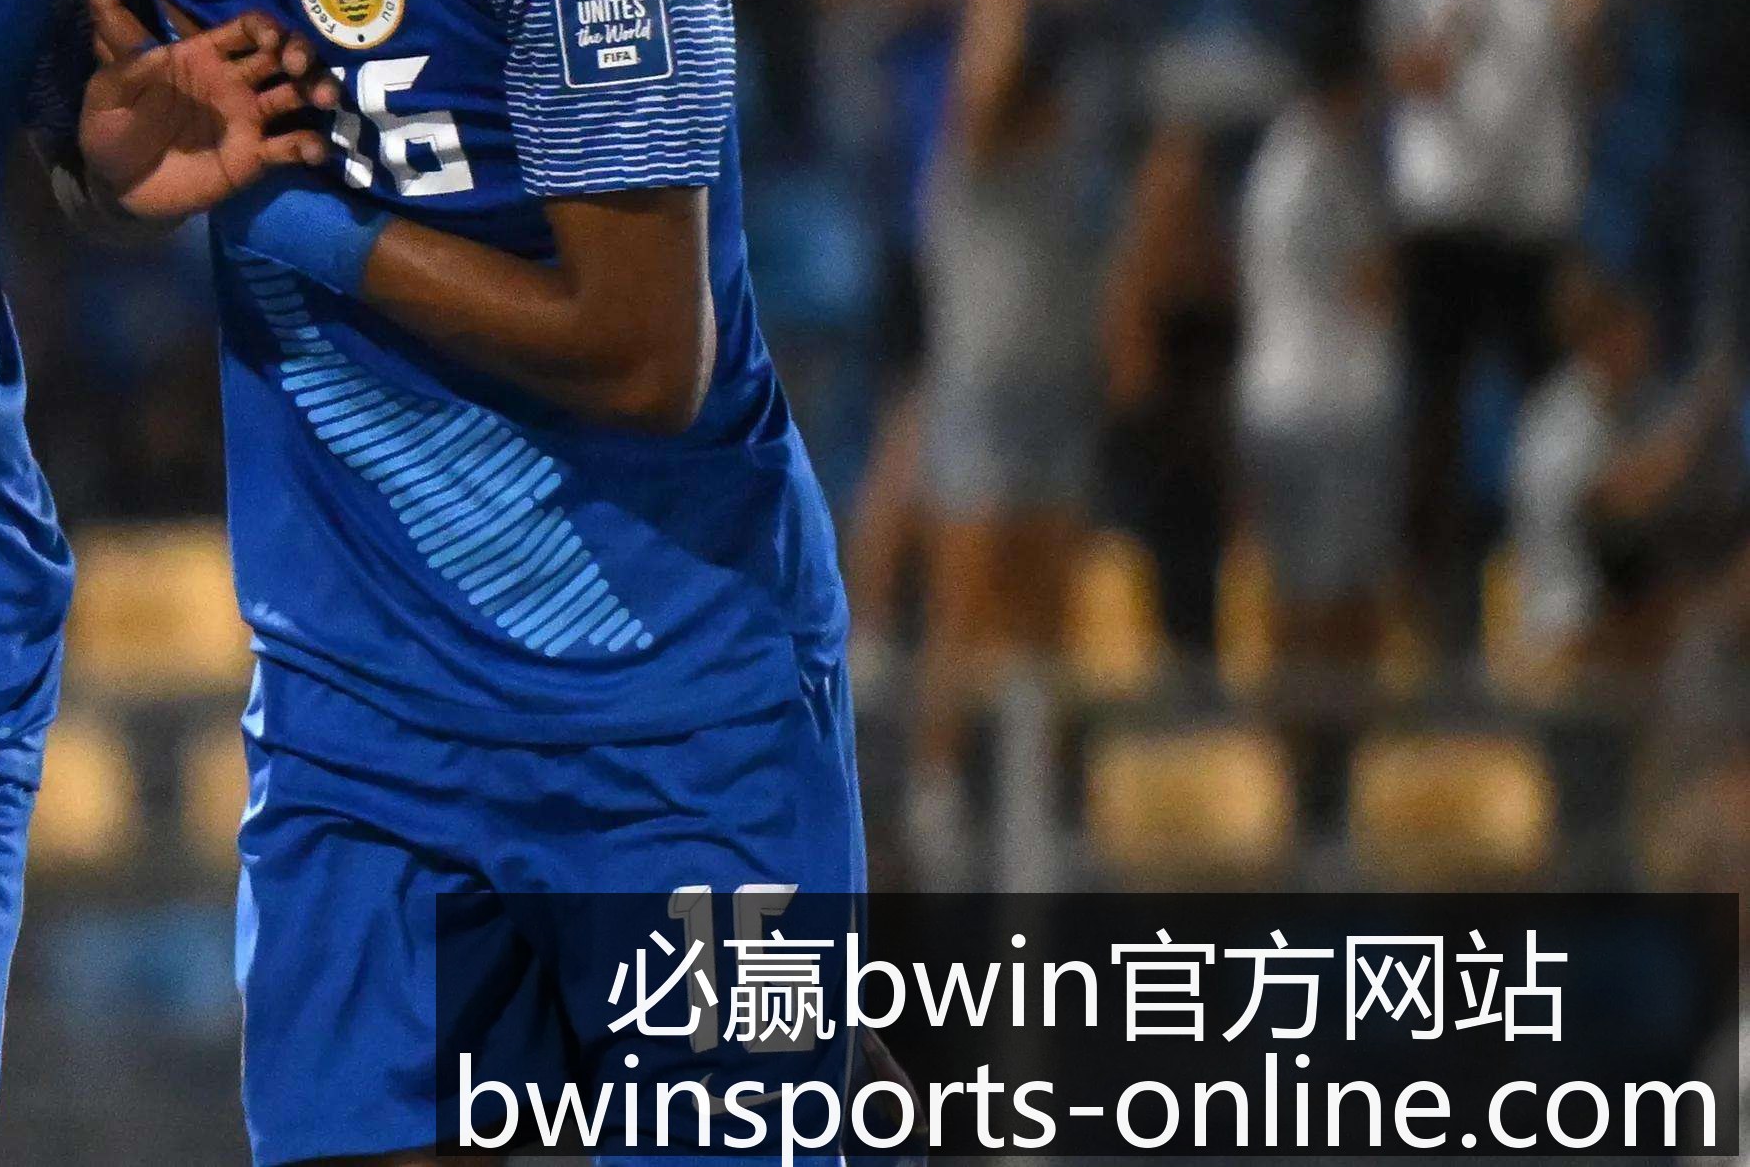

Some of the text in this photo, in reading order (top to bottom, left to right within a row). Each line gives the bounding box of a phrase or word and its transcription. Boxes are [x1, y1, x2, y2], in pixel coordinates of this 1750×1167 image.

[575, 18, 652, 48] the World
[603, 49, 632, 64] FIFA
